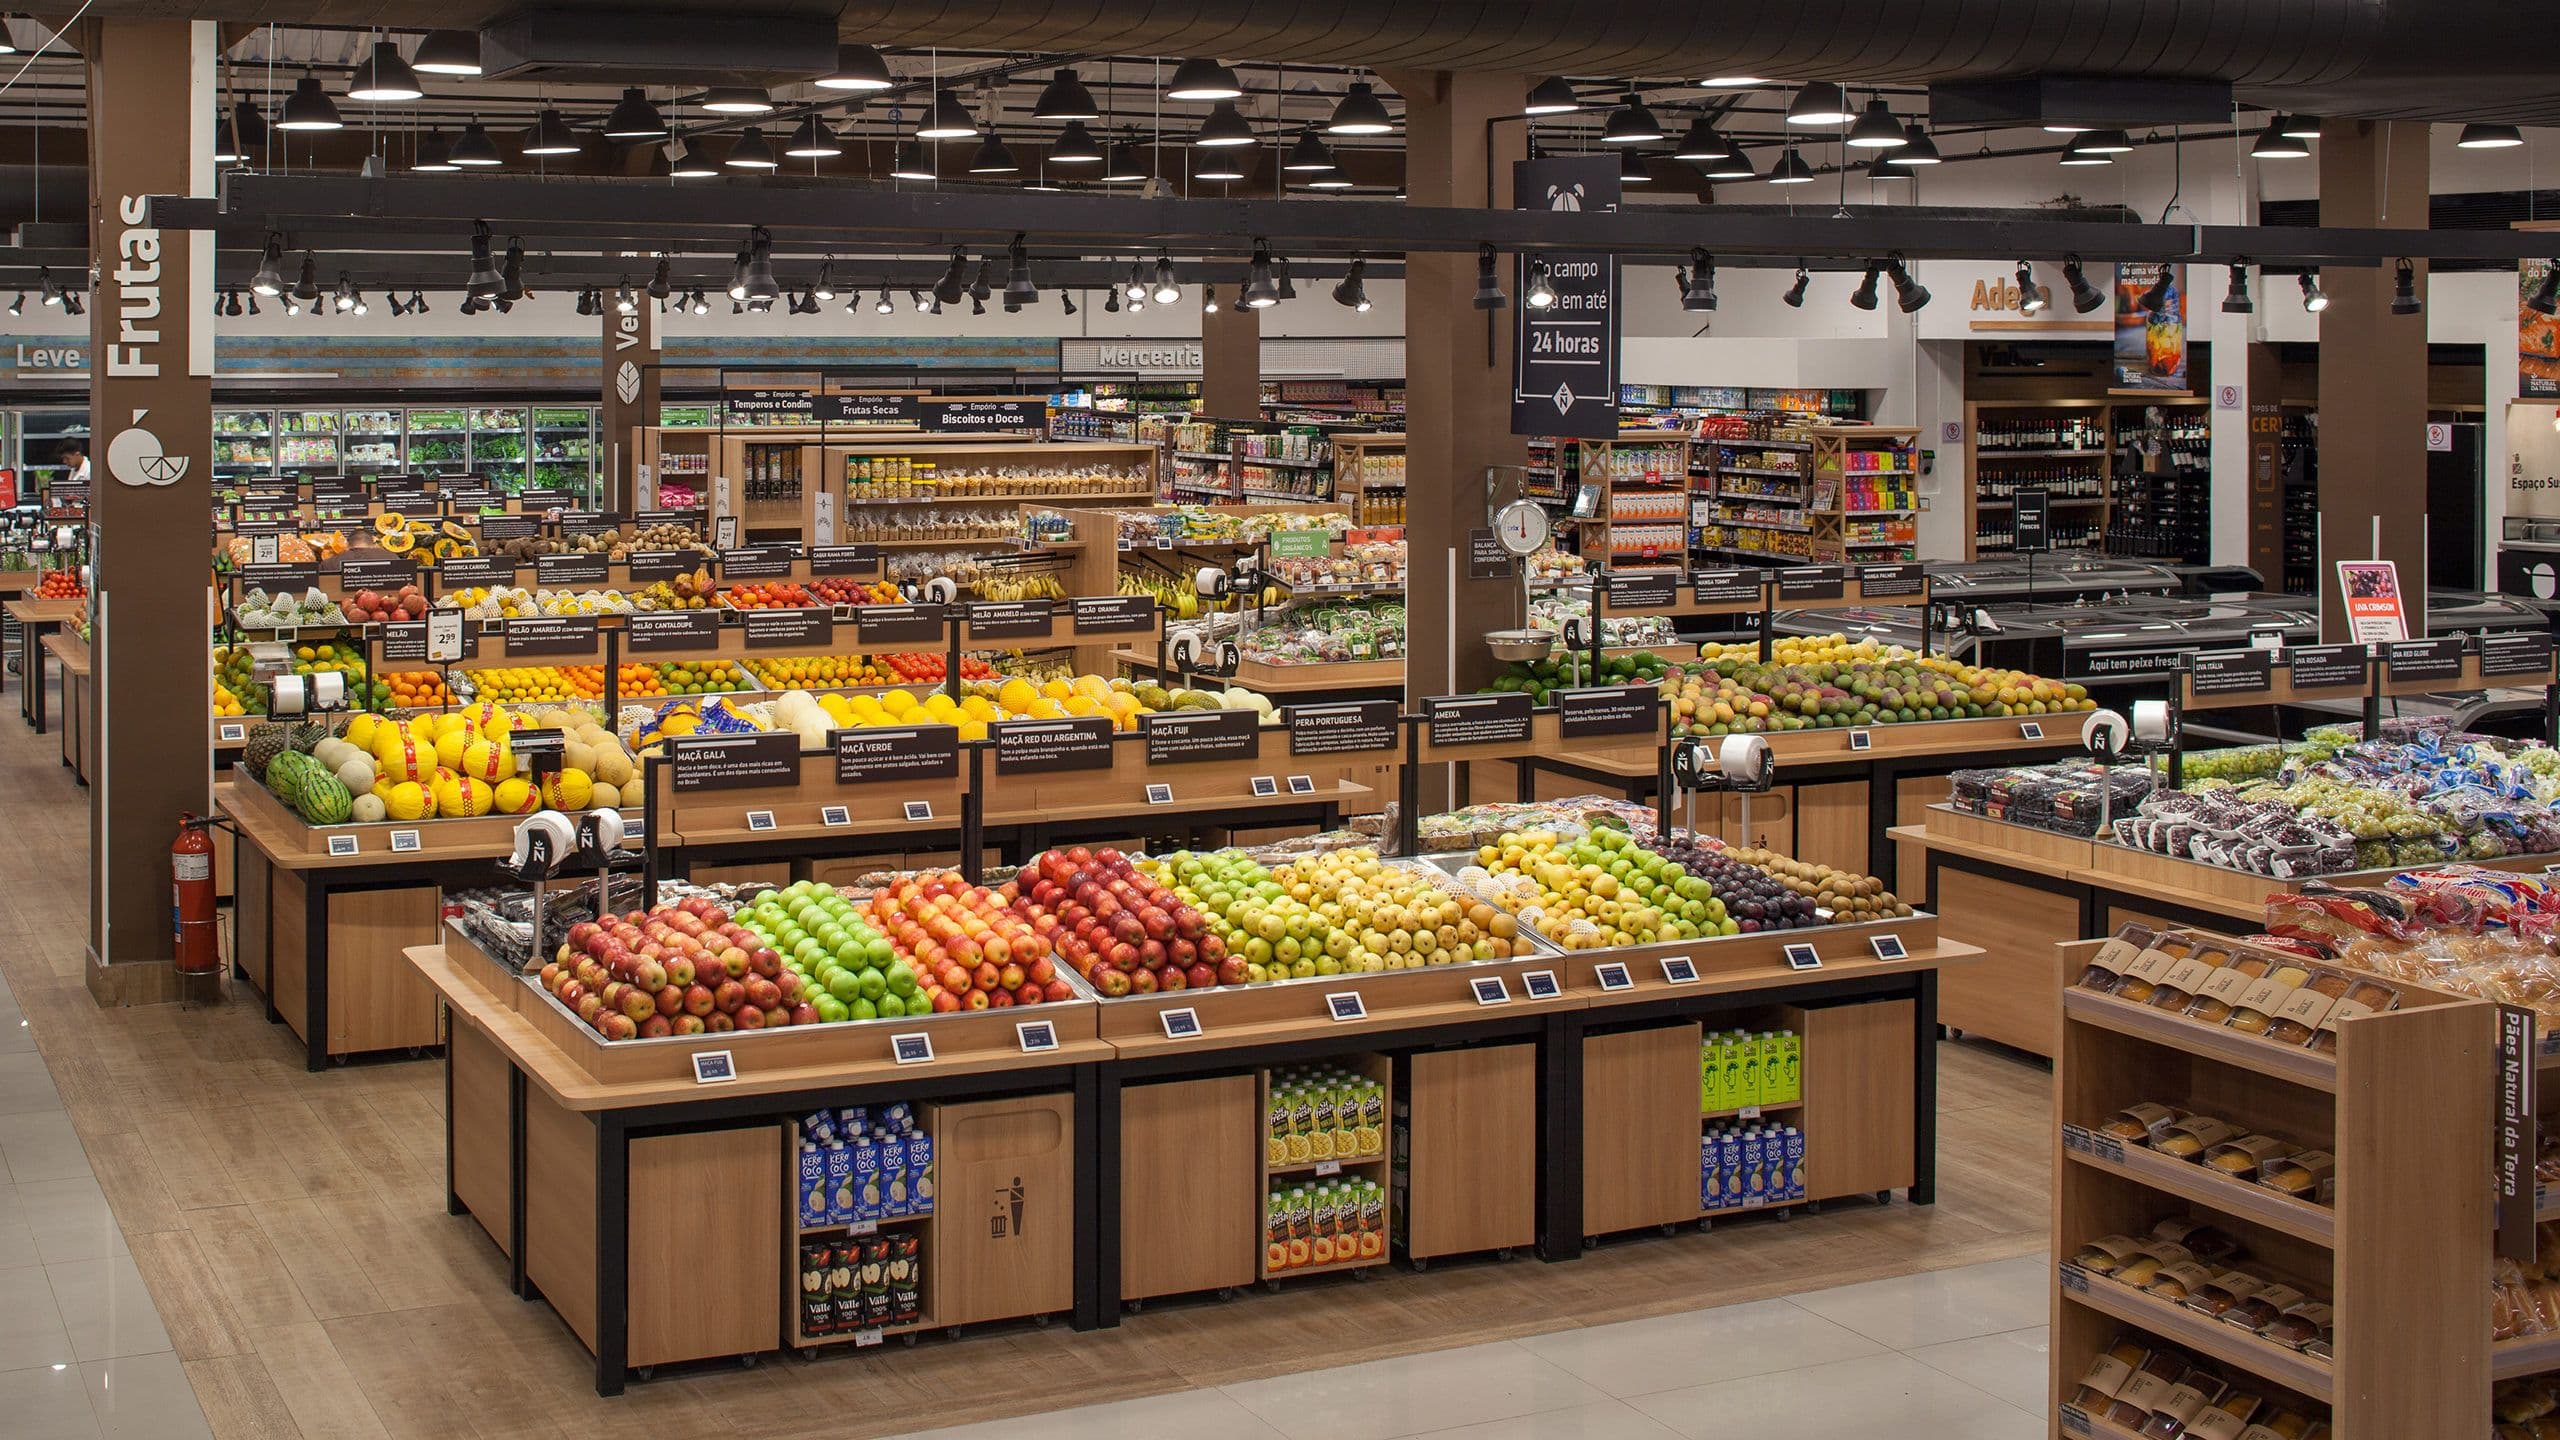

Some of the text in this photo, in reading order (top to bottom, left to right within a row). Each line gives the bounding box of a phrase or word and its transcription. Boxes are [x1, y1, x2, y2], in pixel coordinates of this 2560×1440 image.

[1554, 262, 1598, 280] campo
[2121, 267, 2130, 275] de
[2528, 268, 2538, 277] do
[107, 195, 160, 376] Frutas
[2121, 277, 2138, 286] mais
[1562, 295, 1582, 309] em
[1585, 289, 1607, 309] até
[1532, 330, 1599, 353] 24 horas
[17, 344, 80, 367] Leve
[1100, 344, 1202, 367] Mercearia
[735, 400, 772, 410] Temperos
[859, 396, 883, 404] Empório
[843, 405, 899, 415] Frutas Secas
[970, 403, 997, 411] Empório
[942, 413, 985, 424] Biscoitos
[995, 413, 1024, 423] Doces
[2512, 478, 2545, 491] Espaço
[387, 630, 408, 638] MELÃO
[509, 626, 530, 634] MELÃO
[2090, 659, 2108, 671] Aqui
[2110, 660, 2127, 668] tem
[2129, 658, 2153, 670] peixe
[2306, 656, 2326, 664] ROSADA
[1435, 711, 1460, 719] AMEIXA
[1296, 716, 1362, 727] PERA PORTUGUESA
[1152, 725, 1188, 736] MAÇÃ FUJI
[1001, 732, 1097, 746] MAÇÃ RED OU ARGENTINA
[841, 742, 892, 754] MAÇÃ VERDE
[678, 750, 726, 762] MAÇÃ GALA
[2504, 1012, 2520, 1197] Pães Natural da Terra
[883, 1146, 902, 1157] KERO
[910, 1142, 929, 1153] KERO
[1787, 1147, 1802, 1156] COCO
[830, 1153, 849, 1164] KERO
[857, 1150, 876, 1160] KERO
[910, 1152, 929, 1164] COCO
[1724, 1154, 1739, 1164] COCO
[1746, 1152, 1760, 1161] COCO
[1767, 1149, 1781, 1159] COCO
[803, 1156, 822, 1167] KERO
[857, 1159, 876, 1172] COCO
[883, 1156, 902, 1168] COCO
[1702, 1156, 1717, 1165] COCO
[803, 1166, 822, 1178] COCO
[830, 1163, 849, 1175] COCO
[872, 1305, 888, 1313] 100%
[900, 1302, 915, 1310] 100%
[813, 1313, 829, 1321] 100%
[842, 1310, 857, 1318] 100%
